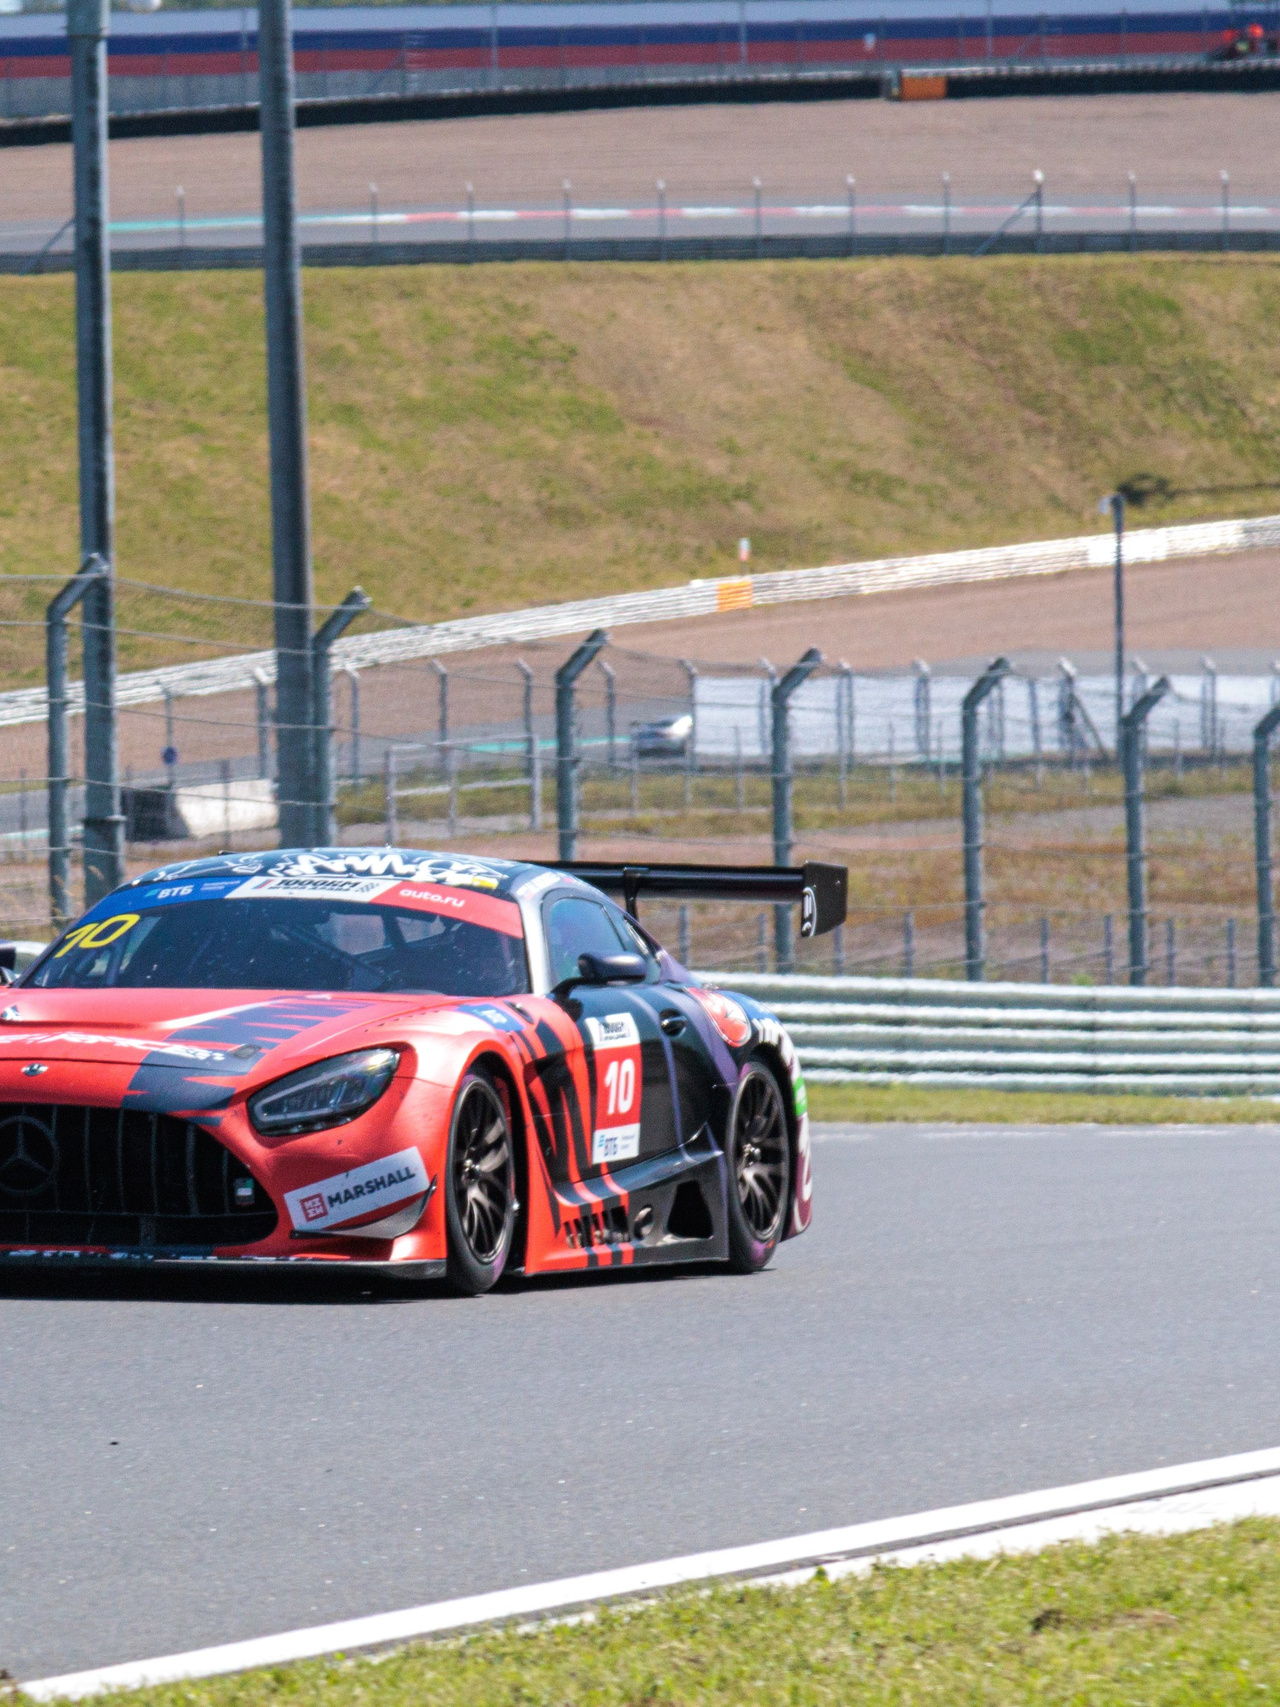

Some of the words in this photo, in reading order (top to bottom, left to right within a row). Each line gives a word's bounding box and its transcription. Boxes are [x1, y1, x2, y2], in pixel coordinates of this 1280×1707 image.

[399, 888, 465, 908] auto.ru
[54, 913, 140, 958] 10
[604, 1058, 635, 1115] 10
[327, 1166, 416, 1208] MARSHALL
